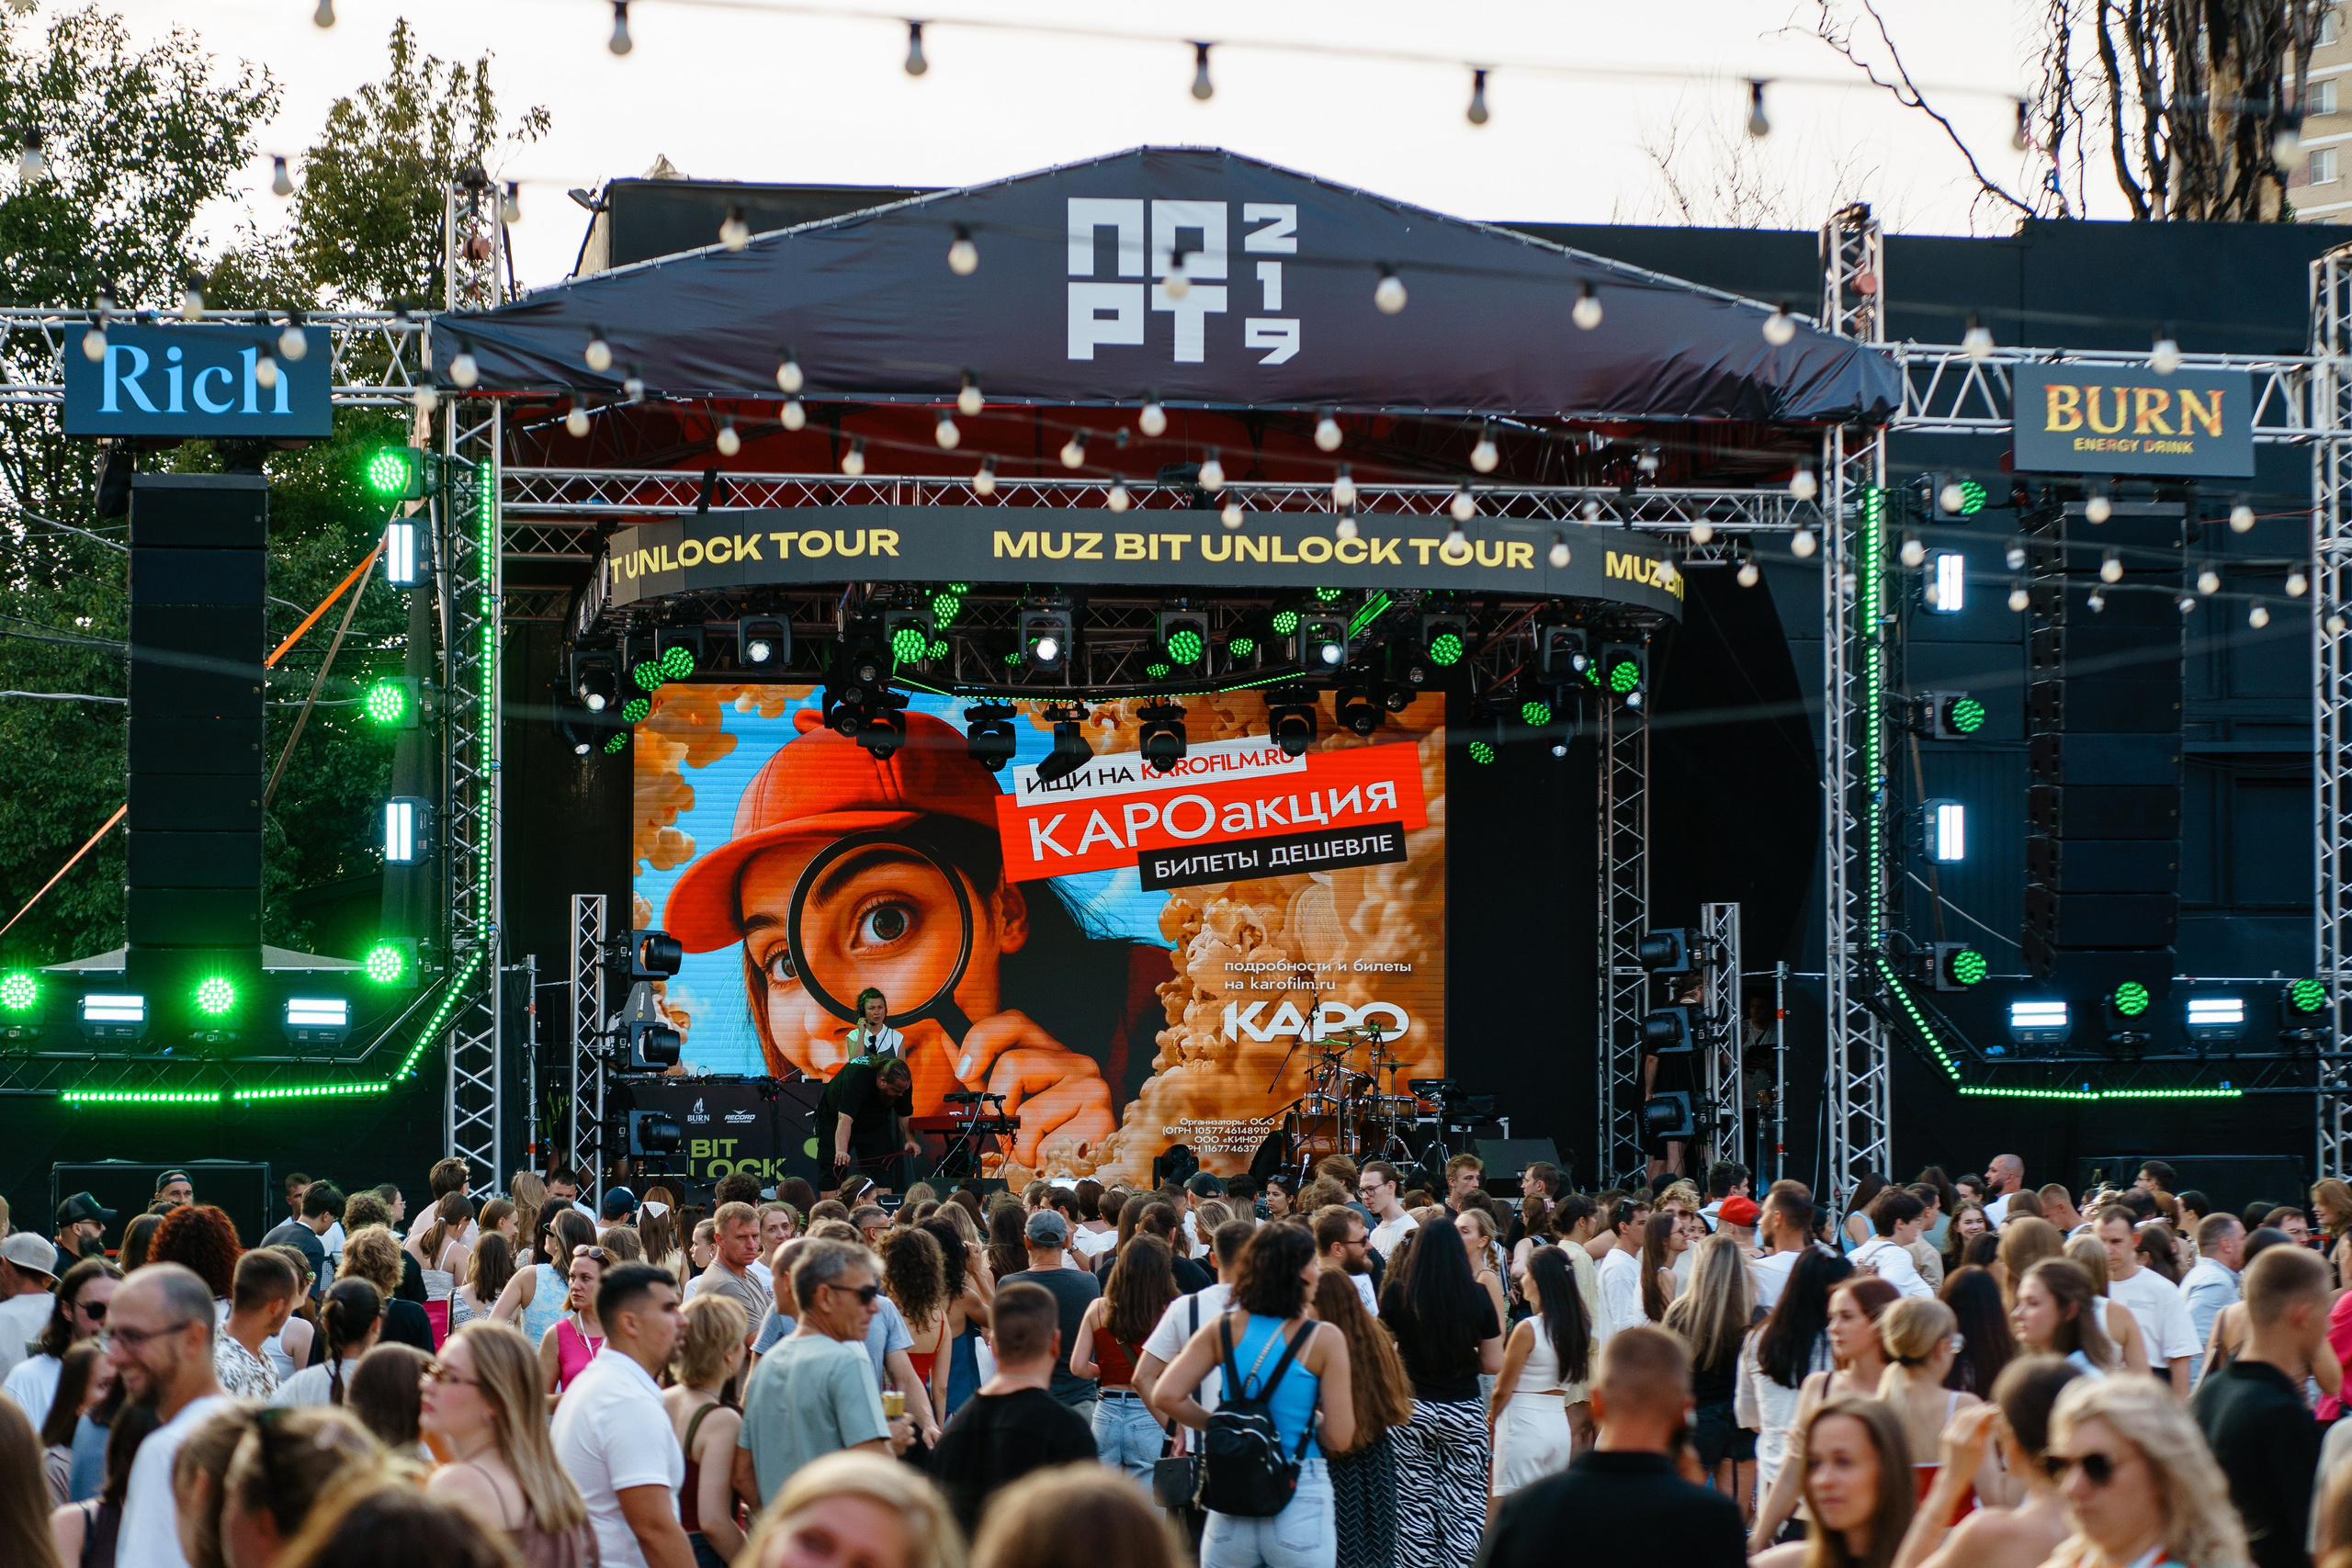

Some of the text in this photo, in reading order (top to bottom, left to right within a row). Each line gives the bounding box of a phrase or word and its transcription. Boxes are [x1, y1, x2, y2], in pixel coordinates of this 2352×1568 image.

[96, 344, 294, 413] Rich
[2044, 384, 2226, 438] BURN
[2074, 437, 2195, 455] ENERGY DRINK
[625, 534, 763, 579] UNLOCK
[770, 529, 900, 559] TOUR
[994, 530, 1534, 569] MUZ BIT UNLOCK TOUR
[1605, 550, 1662, 588] MUZ
[1026, 770, 1091, 794] ИЩИ
[1099, 766, 1136, 785] НА
[1028, 780, 1397, 862] КАРОакция
[1154, 834, 1394, 878] БИЛЕТЫ ДЕШЕВЛЕ
[1225, 959, 1411, 975] подробности и билеты
[1225, 976, 1336, 990] на karofilm.ru
[1162, 1126, 1271, 1136] (ОГРН 1057746148910
[1180, 1117, 1247, 1126] Организаторы:
[1250, 1117, 1275, 1125] ООО
[691, 1139, 738, 1157] BIT
[1194, 1135, 1219, 1144] ООО
